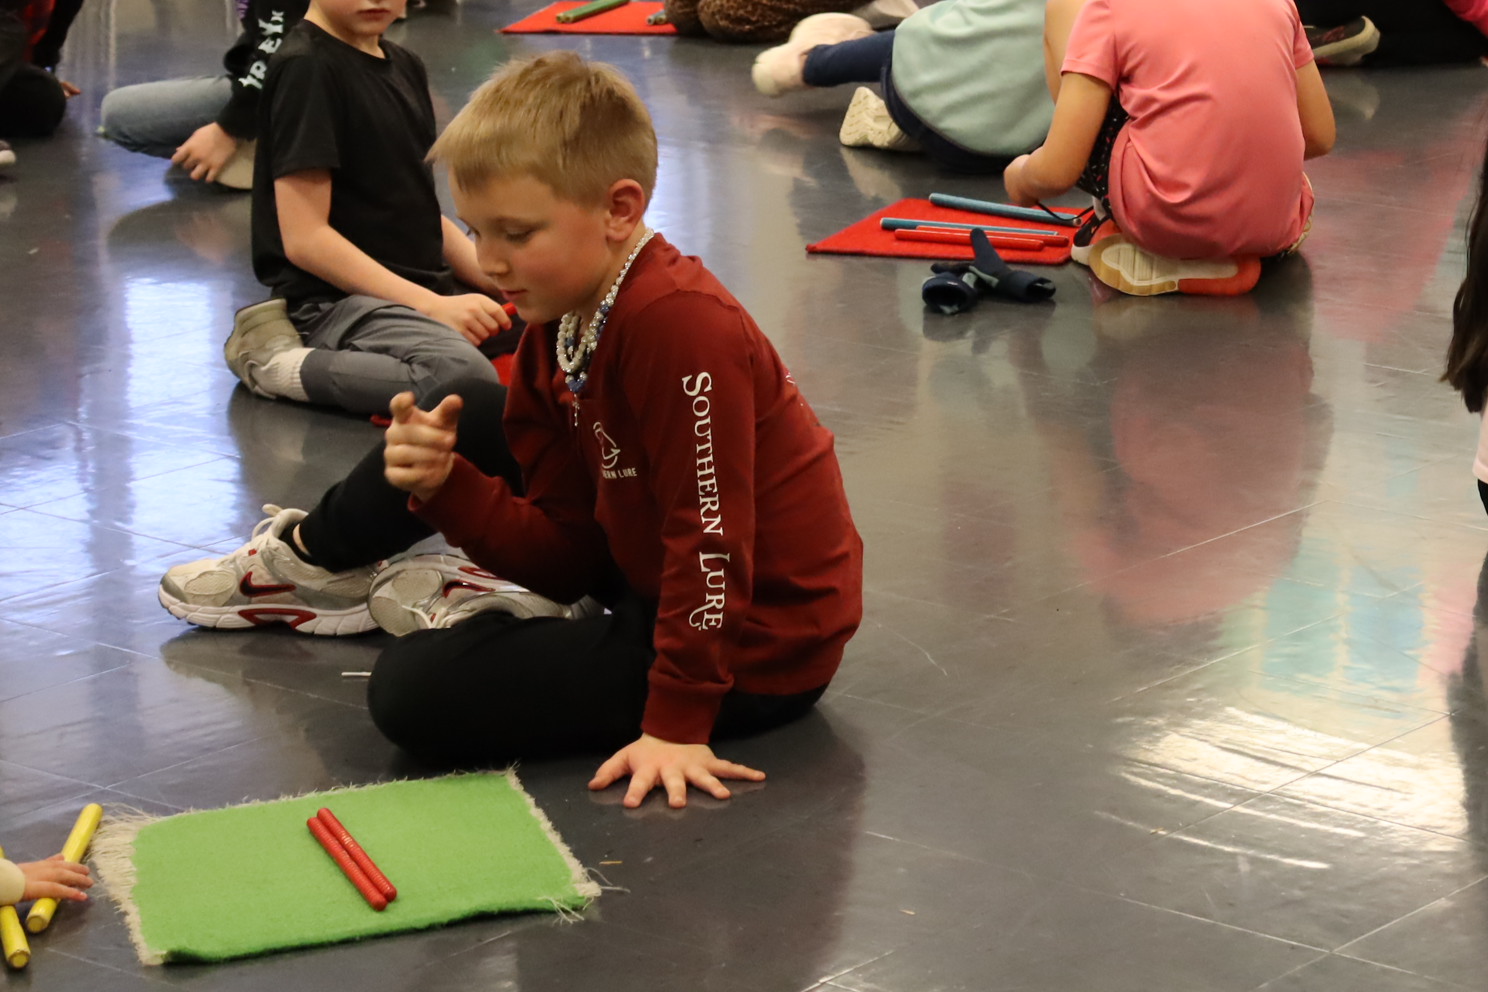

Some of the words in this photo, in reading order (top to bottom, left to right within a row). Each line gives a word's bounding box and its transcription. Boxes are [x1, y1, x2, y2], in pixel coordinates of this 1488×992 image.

[618, 467, 638, 478] LURE
[682, 370, 724, 537] SOUTHERN
[689, 551, 731, 631] LURE
